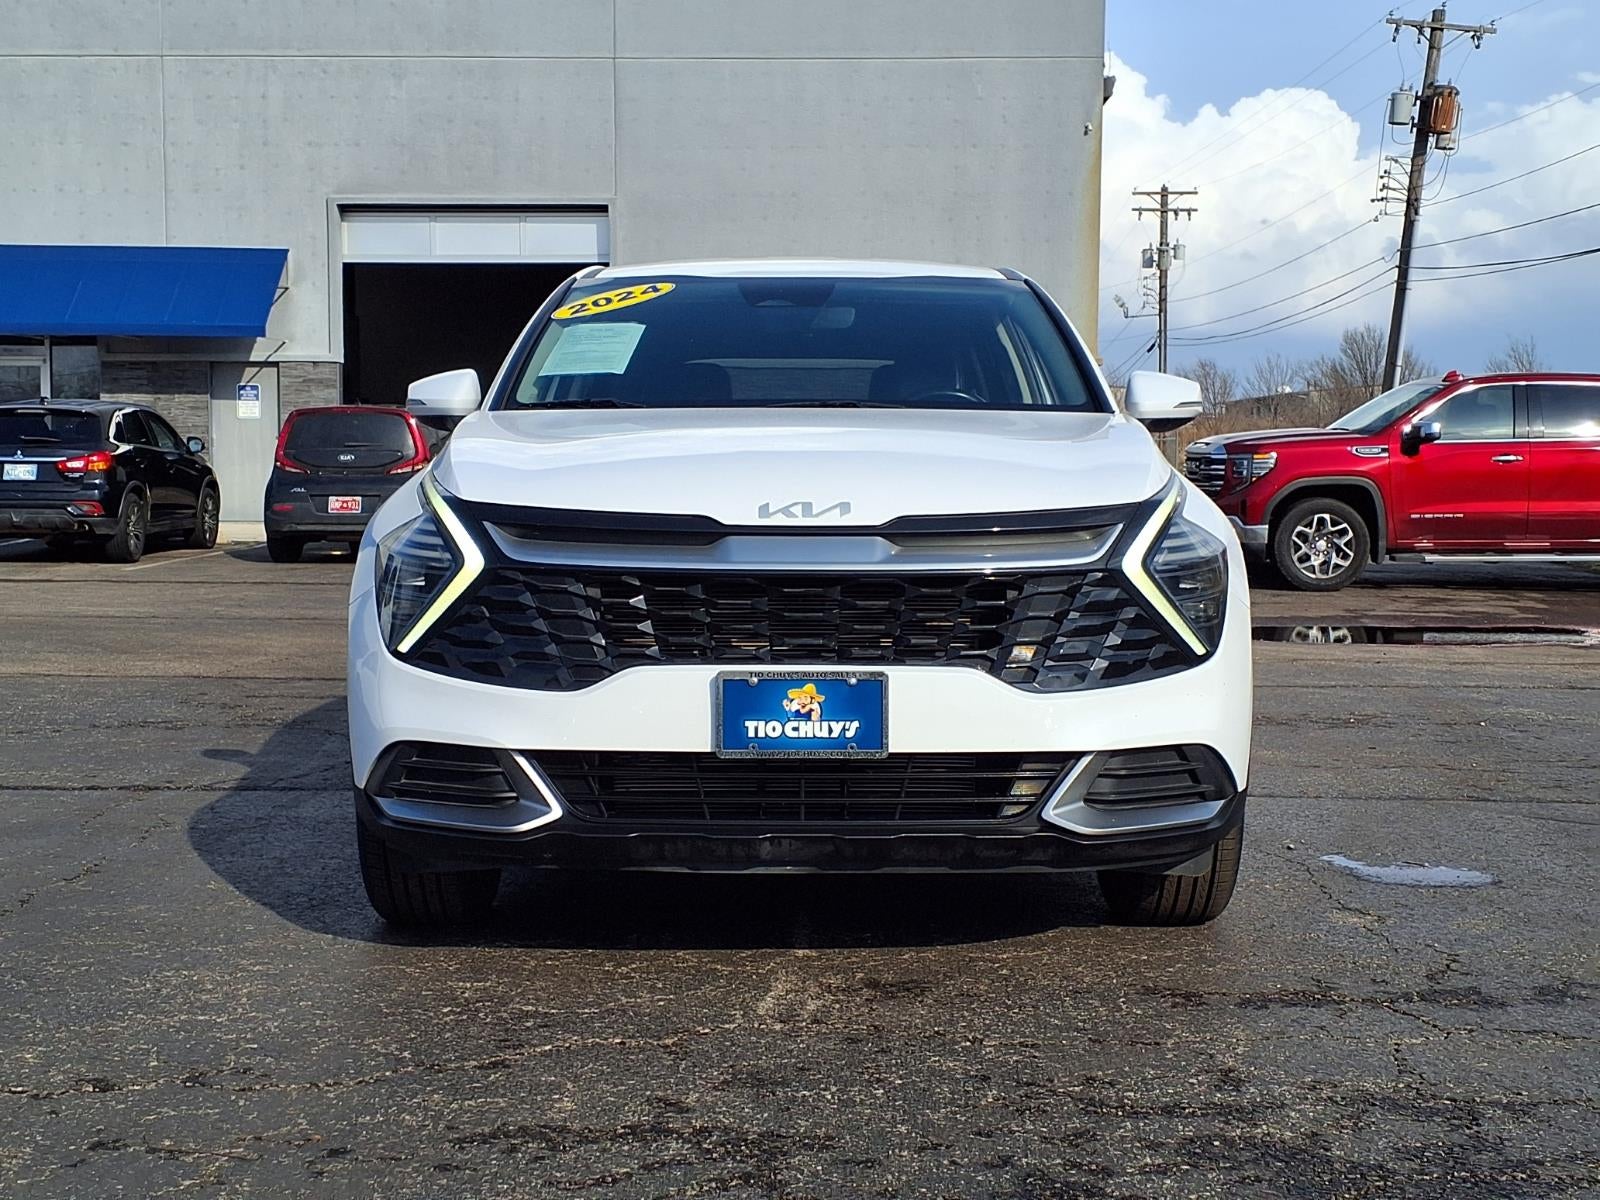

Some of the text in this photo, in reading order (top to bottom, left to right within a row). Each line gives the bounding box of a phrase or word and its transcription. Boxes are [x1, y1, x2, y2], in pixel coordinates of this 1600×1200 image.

[567, 284, 663, 316] 2024
[758, 501, 851, 519] KIA
[744, 720, 860, 738] TIO CHUY'S
